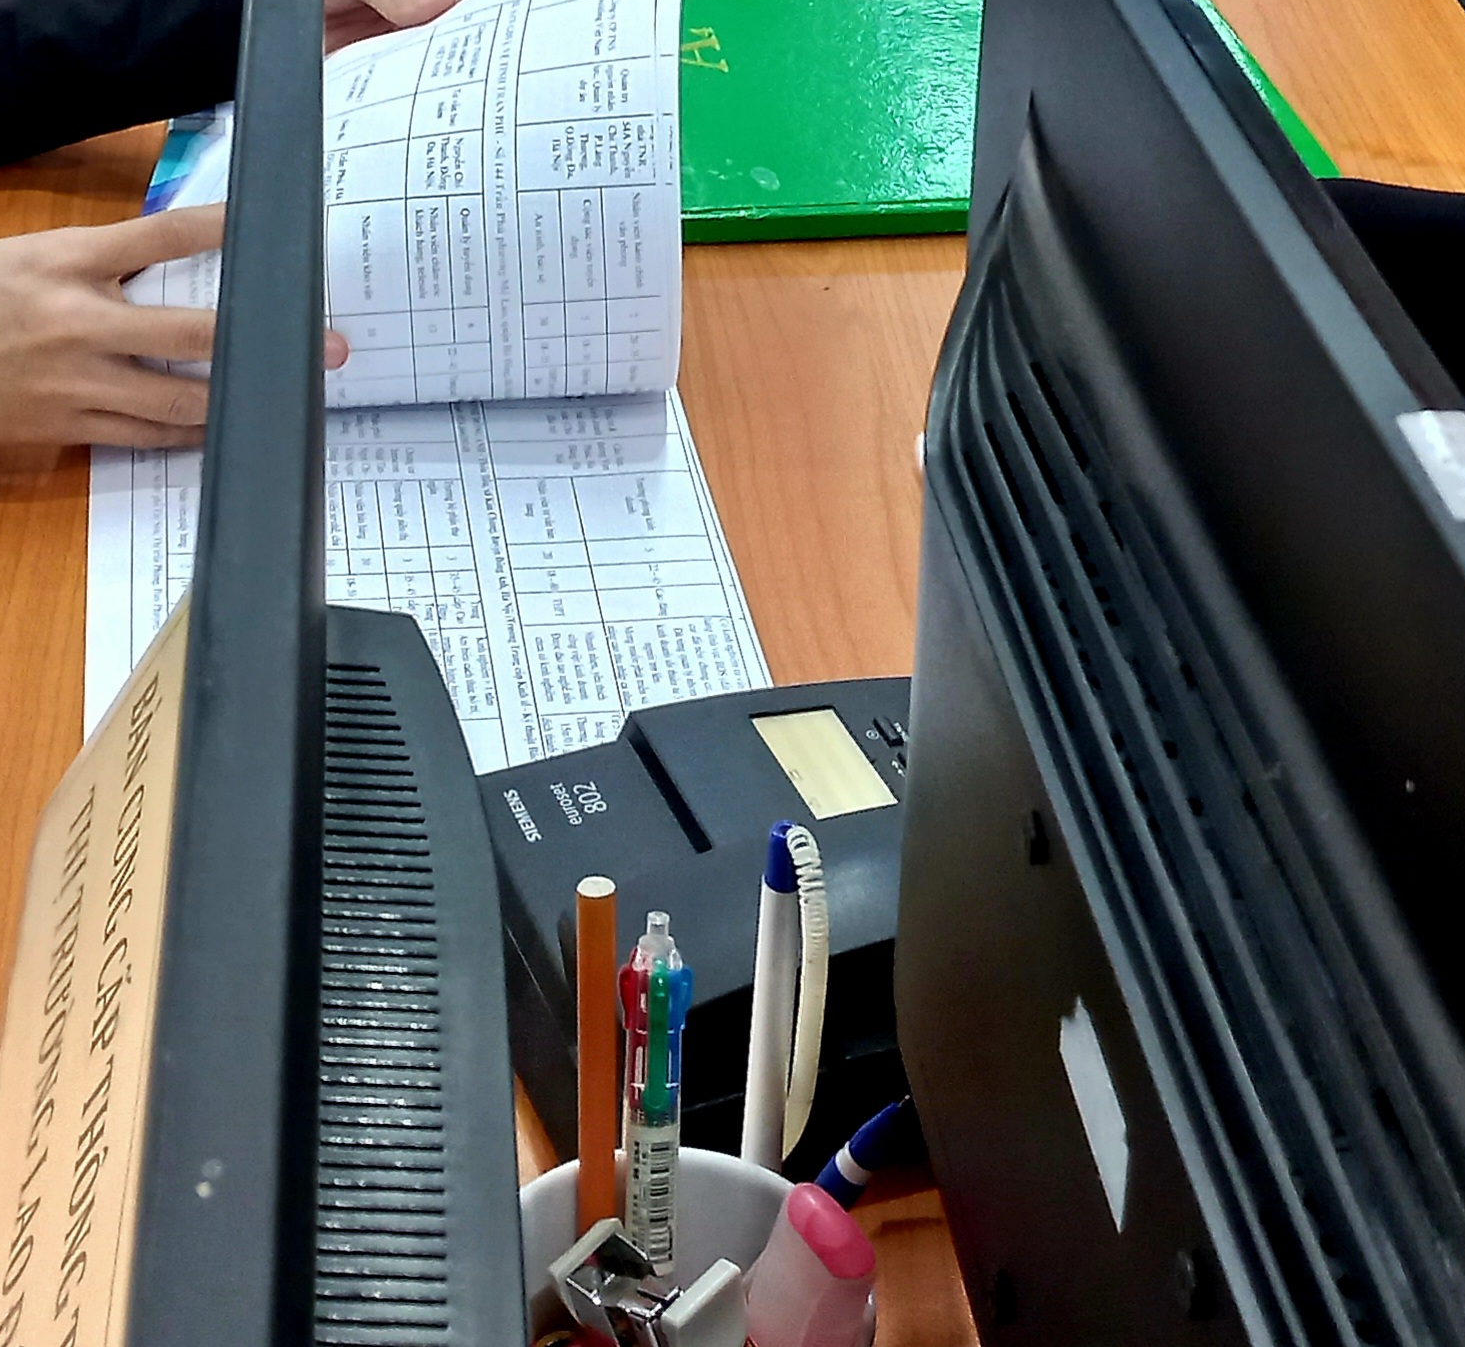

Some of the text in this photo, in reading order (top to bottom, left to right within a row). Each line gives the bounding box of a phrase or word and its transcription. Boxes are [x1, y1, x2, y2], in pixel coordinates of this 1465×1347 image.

[502, 788, 543, 844] SIEMENS
[549, 781, 583, 826] euroset
[572, 779, 608, 814] 802
[103, 783, 145, 946] CUNG
[26, 882, 85, 1160] TRƯỜNG
[89, 937, 132, 1056] CẤP
[1, 1146, 50, 1297] LAO
[53, 1052, 114, 1322] THÔNG
